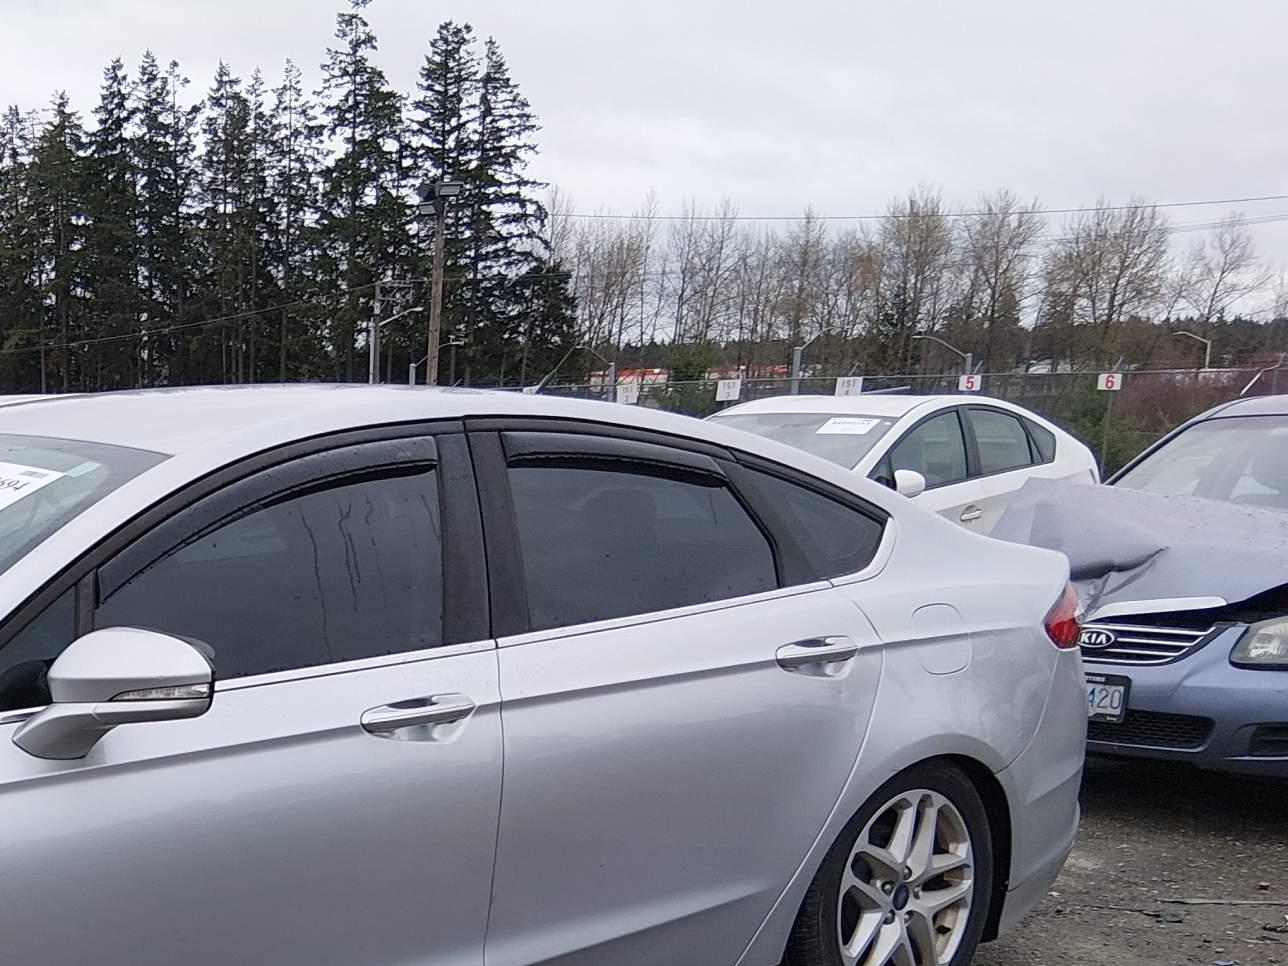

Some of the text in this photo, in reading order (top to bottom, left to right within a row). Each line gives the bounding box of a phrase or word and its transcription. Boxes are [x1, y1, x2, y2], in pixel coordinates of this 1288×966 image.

[966, 375, 974, 390] 5
[1106, 375, 1114, 389] 6
[1080, 632, 1107, 644] KIA
